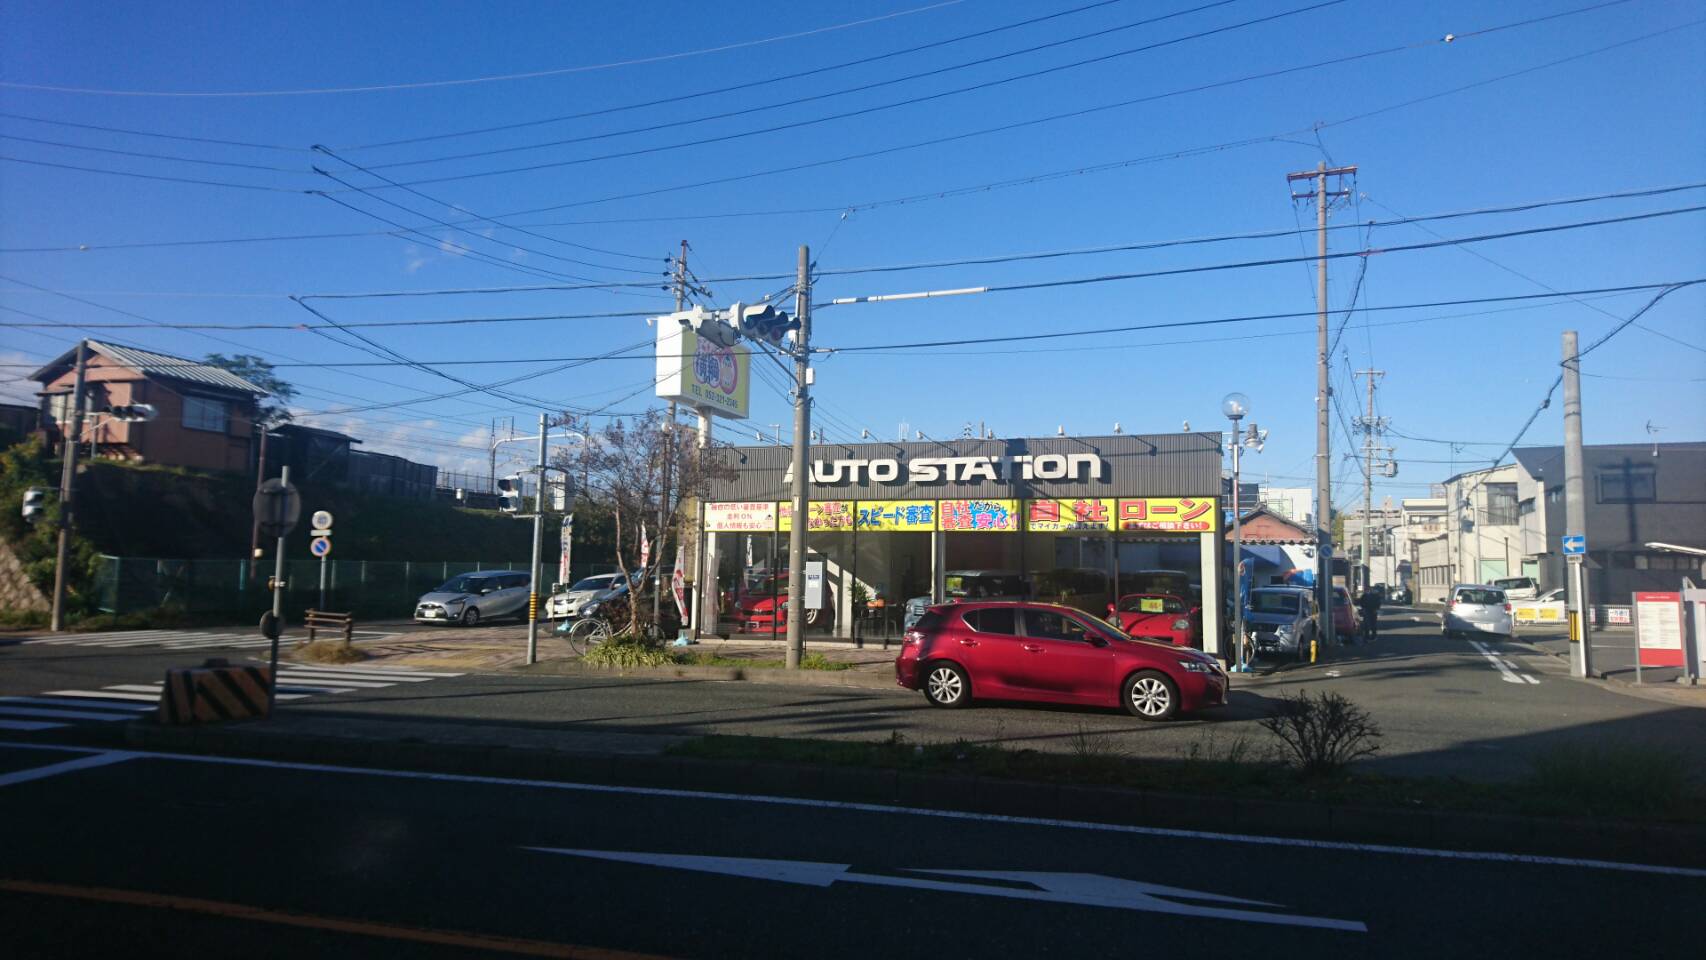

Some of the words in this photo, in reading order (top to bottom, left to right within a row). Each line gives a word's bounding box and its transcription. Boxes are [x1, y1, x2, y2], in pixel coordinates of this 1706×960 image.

[692, 384, 703, 397] TEL
[858, 504, 934, 526] スピード審査
[941, 500, 971, 514] 自社
[974, 501, 1001, 513] だから
[1029, 499, 1109, 522] 自社
[1119, 500, 1211, 521] ローン
